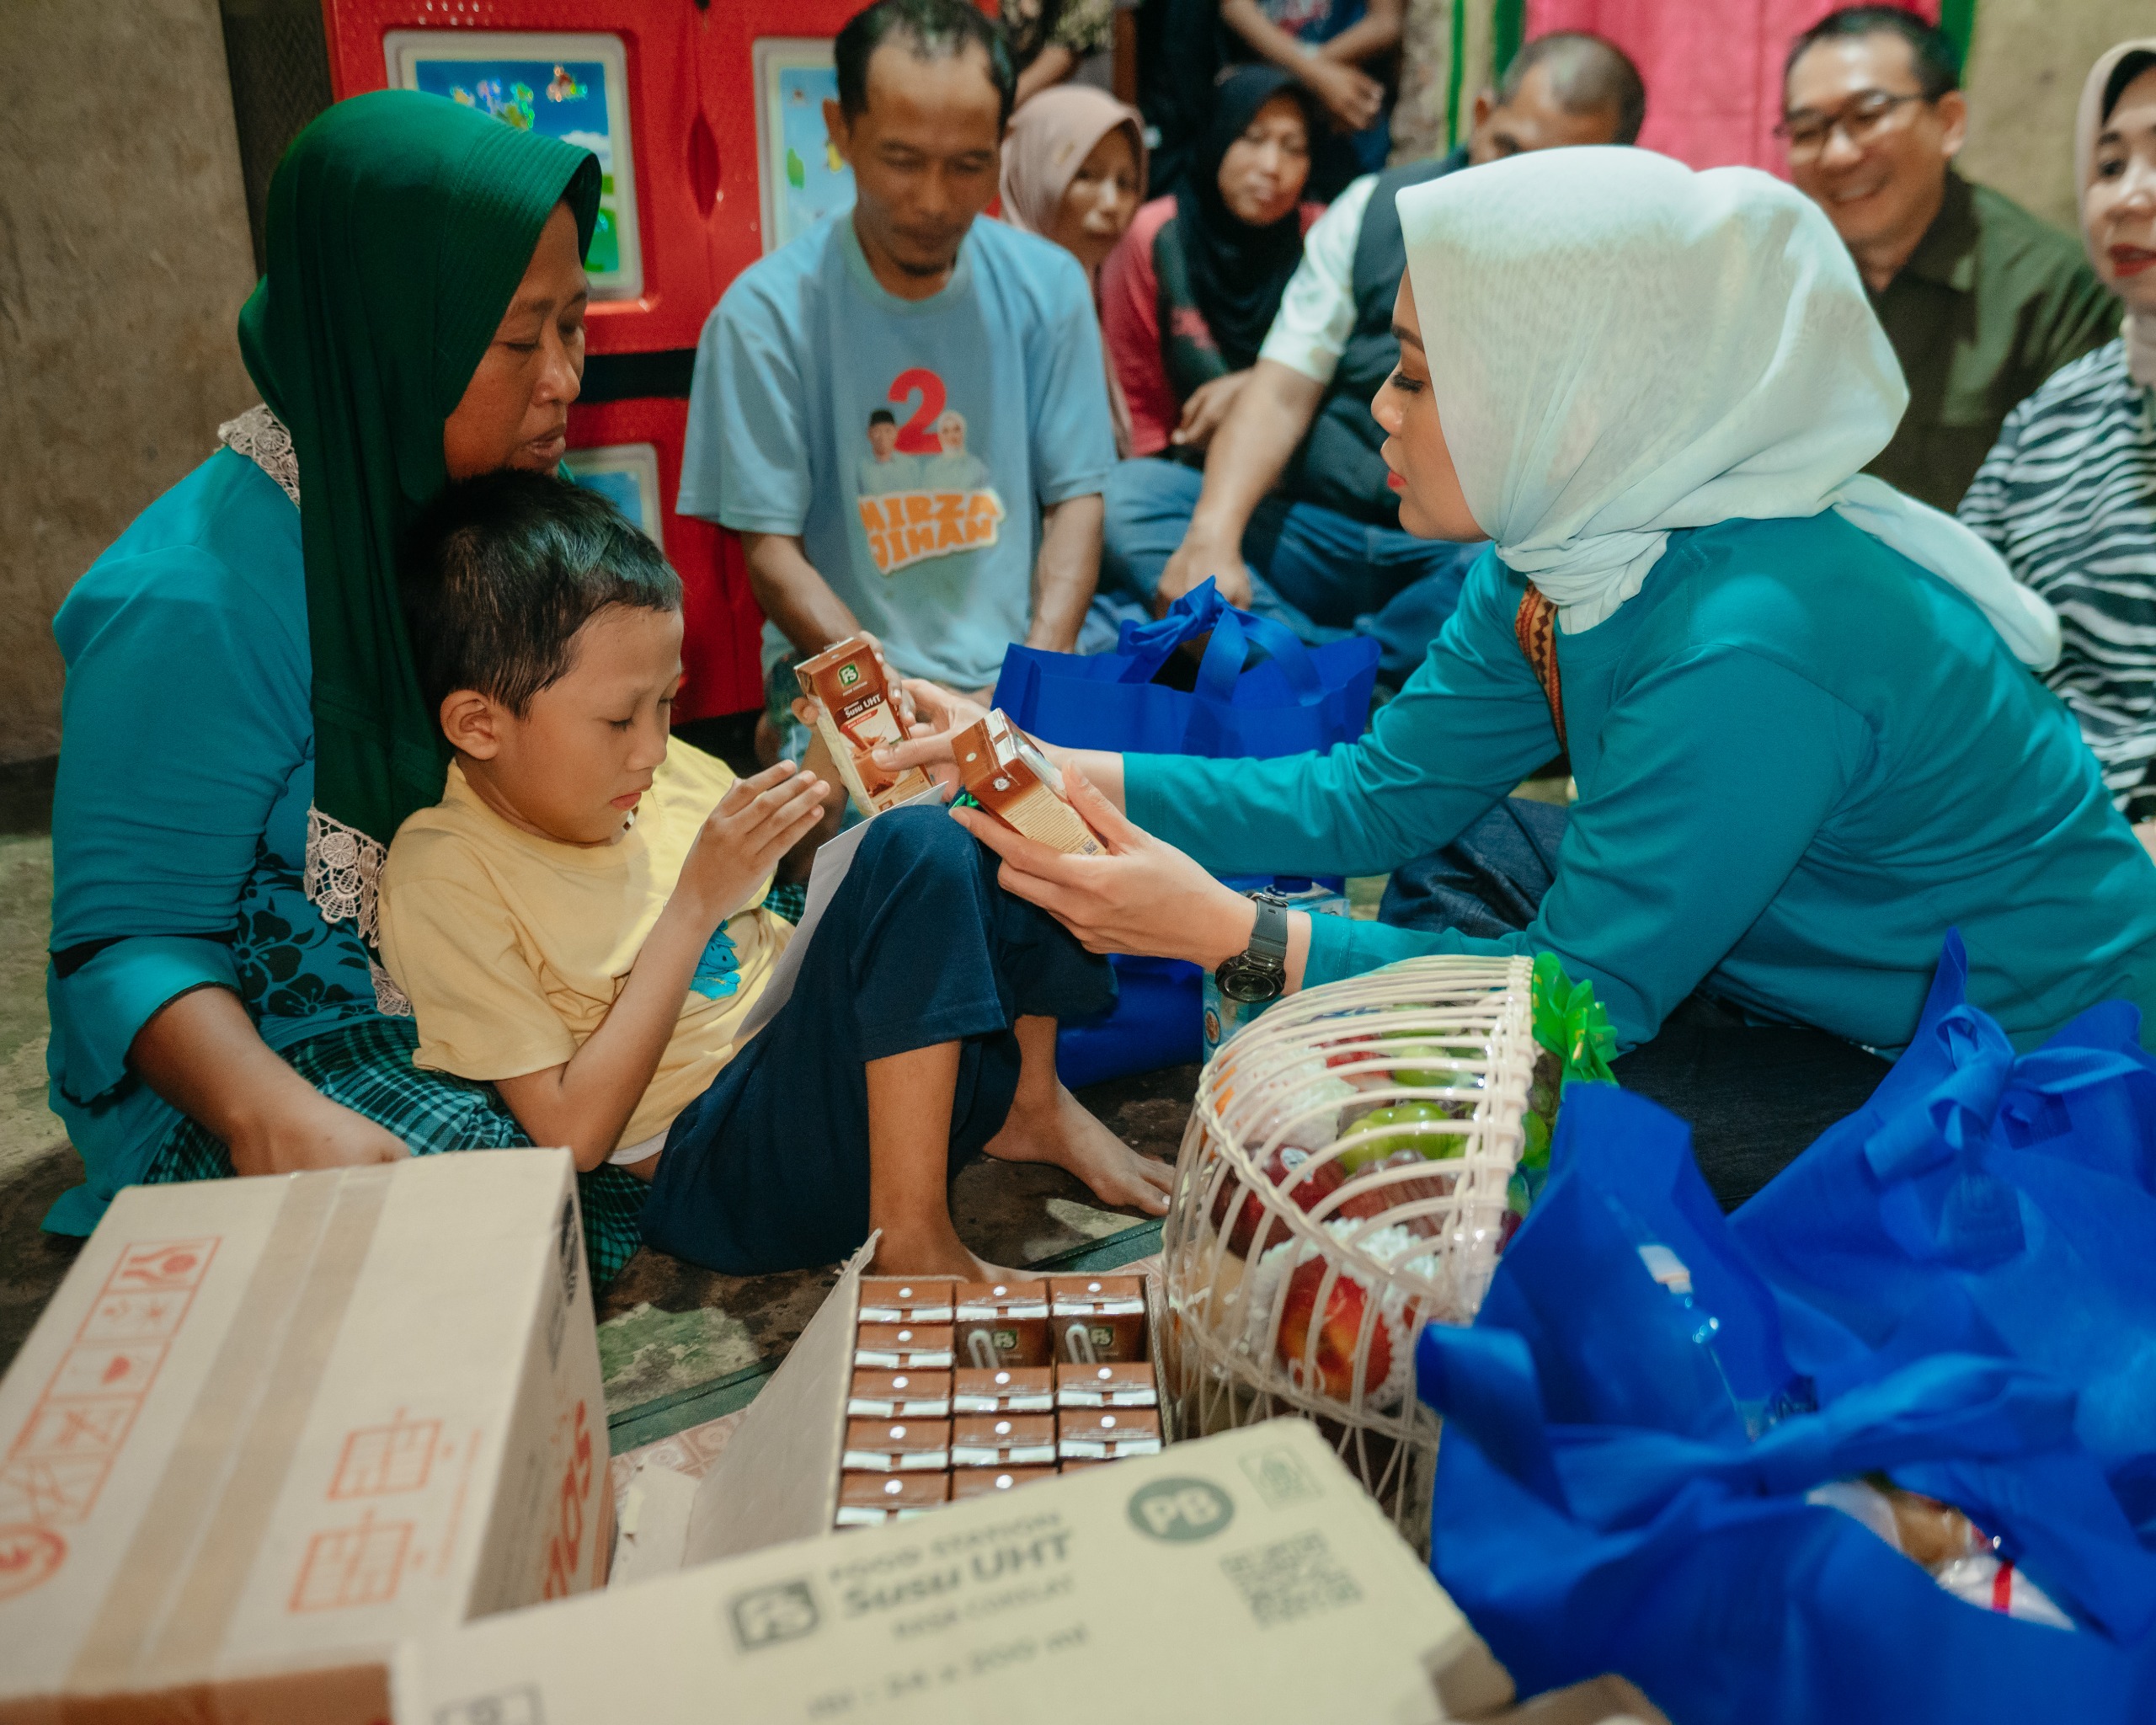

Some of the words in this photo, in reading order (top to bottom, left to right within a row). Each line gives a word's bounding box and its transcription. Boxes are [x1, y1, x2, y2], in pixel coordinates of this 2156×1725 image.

[888, 367, 947, 455] 2
[845, 704, 863, 718] Susu
[863, 694, 881, 708] UHT
[1140, 1485, 1220, 1535] PB
[844, 1567, 962, 1617] Susu
[970, 1529, 1074, 1583] UHT
